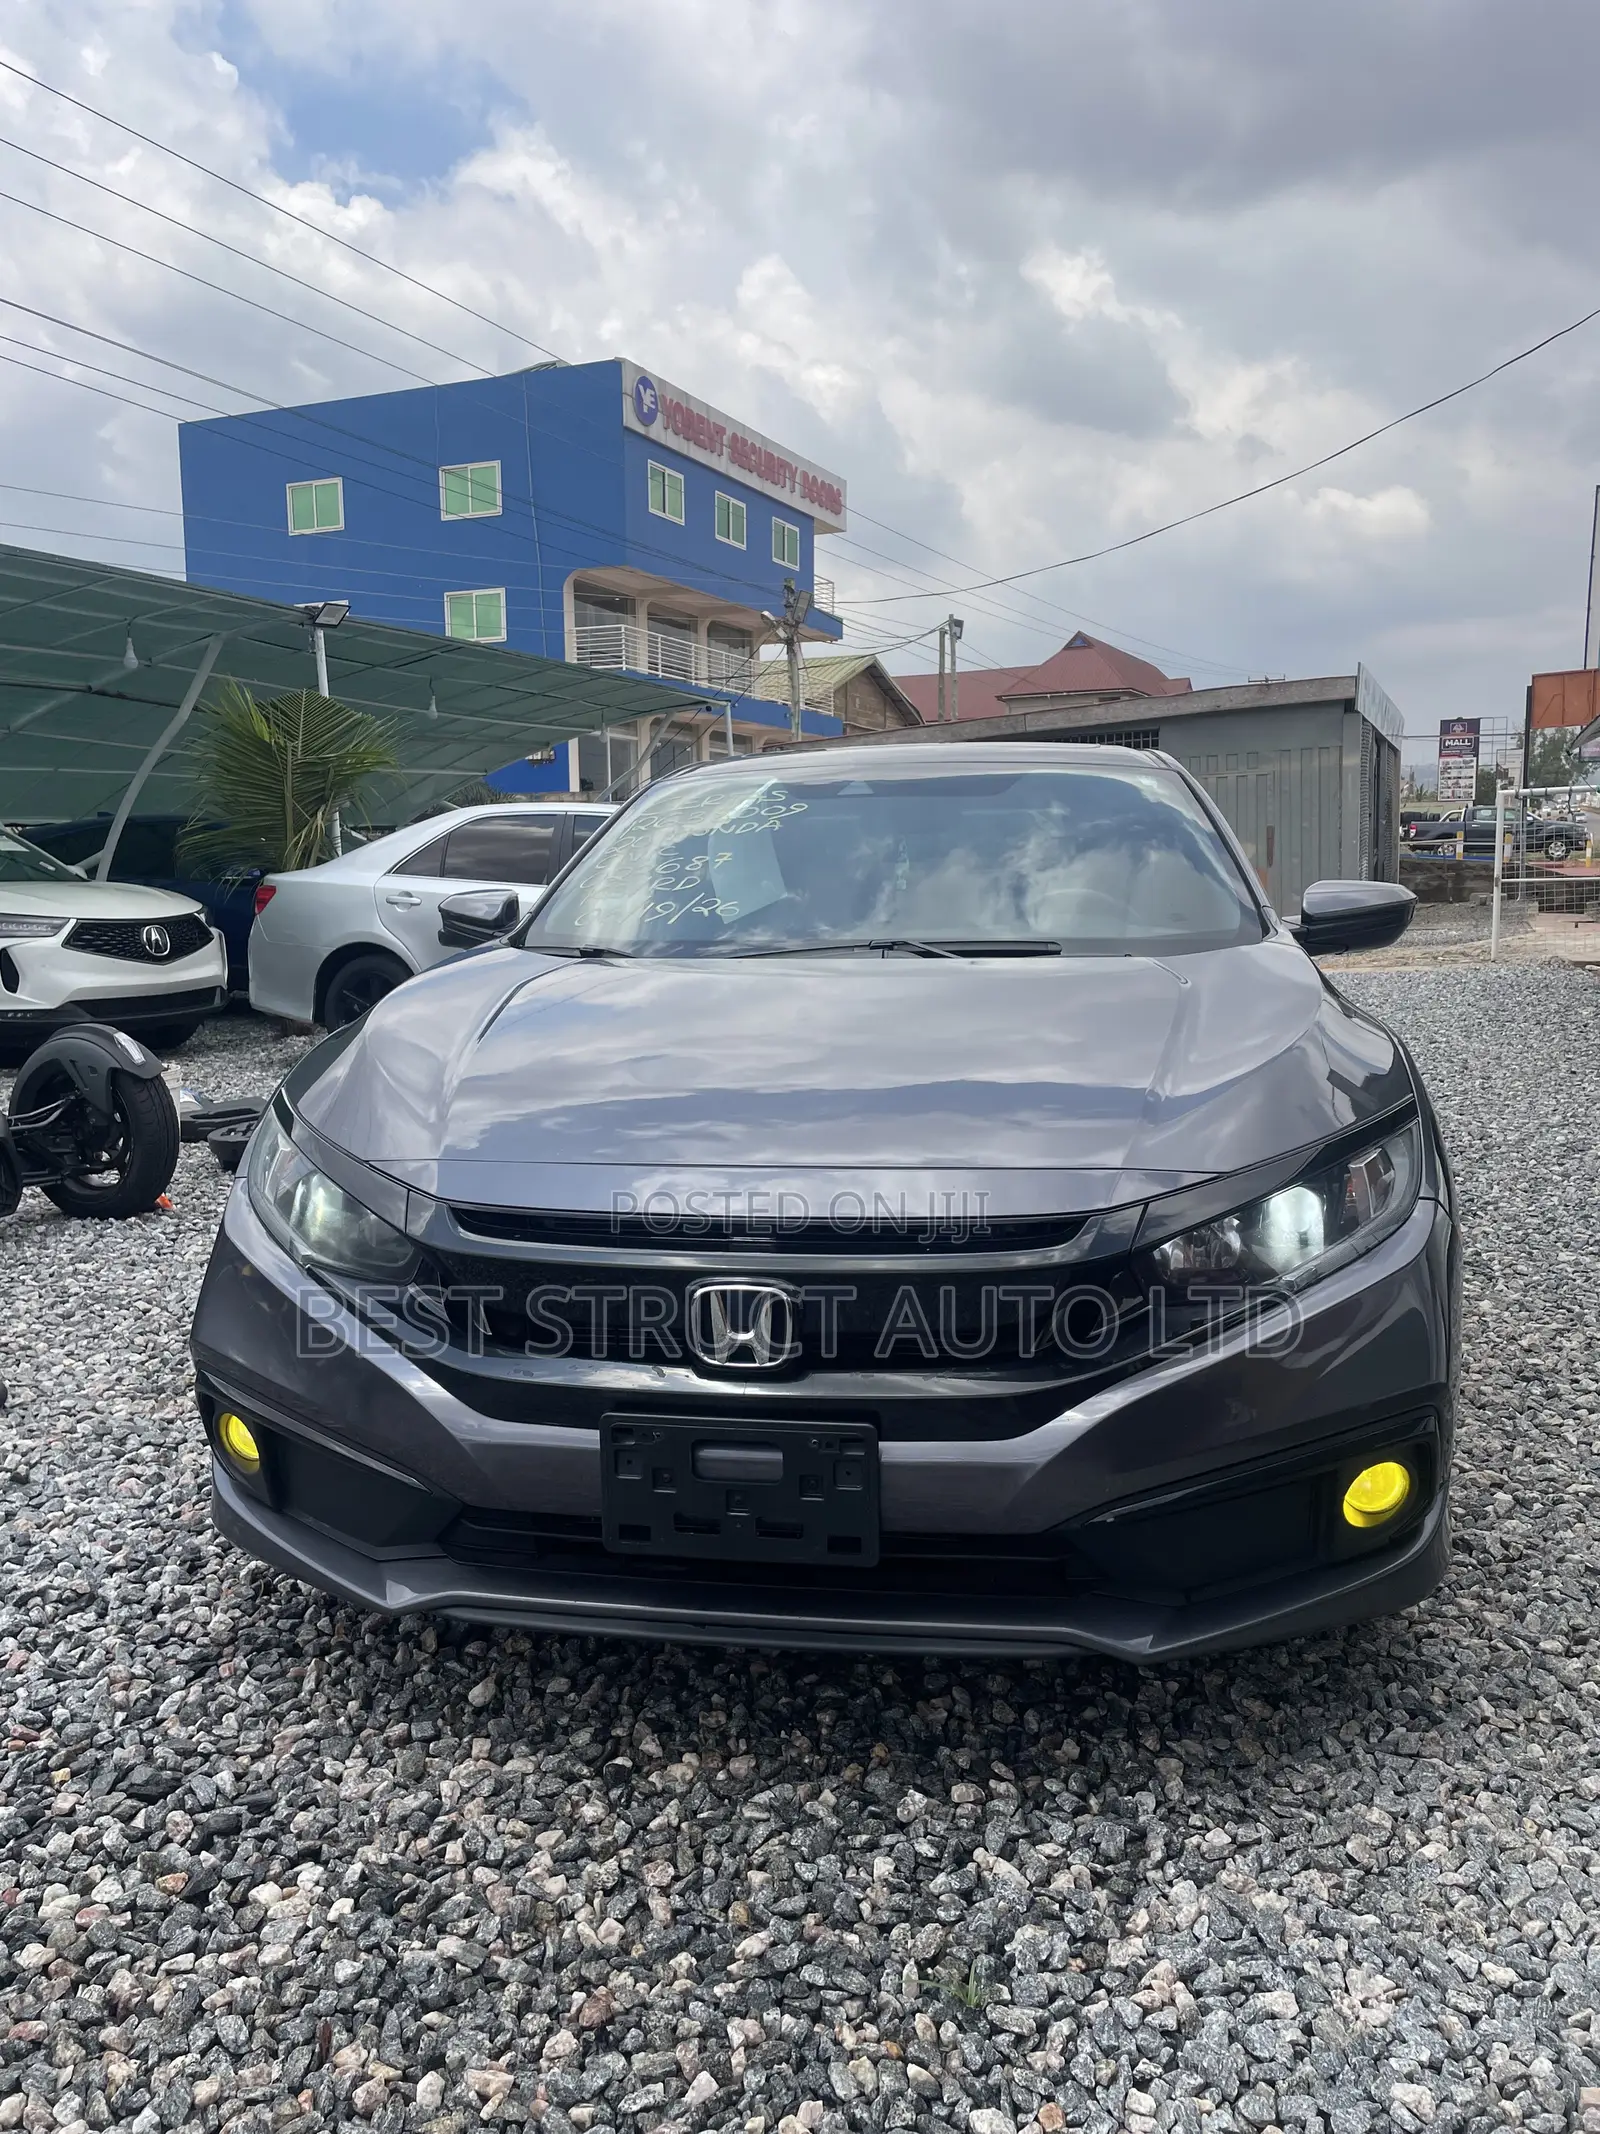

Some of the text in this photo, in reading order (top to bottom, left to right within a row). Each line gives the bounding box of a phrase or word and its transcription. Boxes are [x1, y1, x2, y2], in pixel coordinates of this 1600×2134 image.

[728, 432, 799, 493] SECURITY
[799, 470, 842, 515] DOORS
[1445, 737, 1472, 747] MALL
